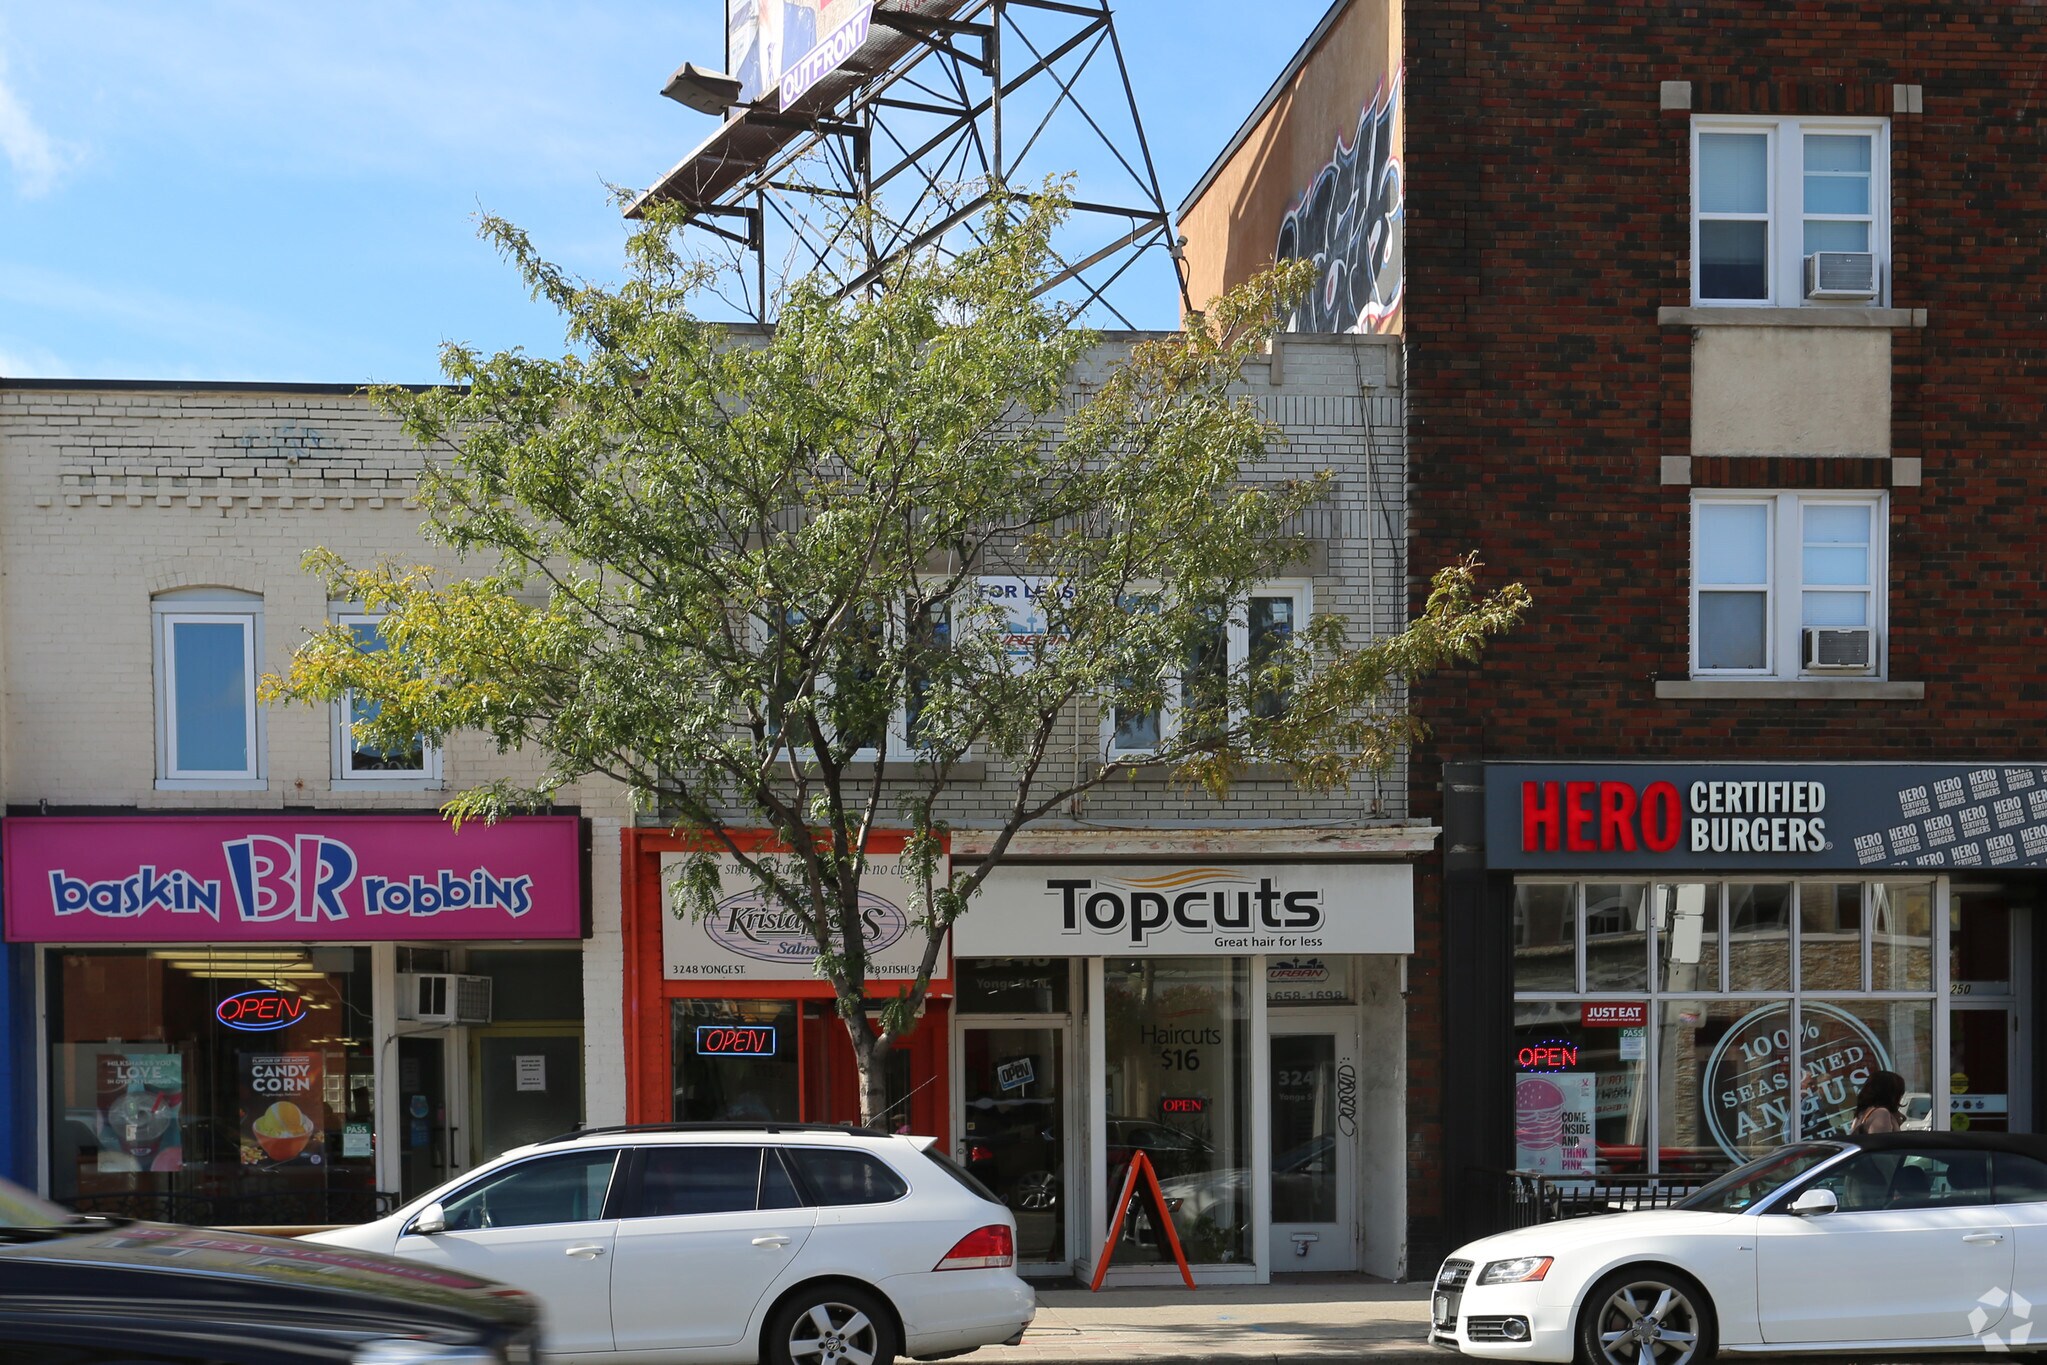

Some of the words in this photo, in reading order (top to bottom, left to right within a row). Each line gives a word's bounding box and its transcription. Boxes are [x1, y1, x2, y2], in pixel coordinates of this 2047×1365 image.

[782, 8, 867, 104] OUTFRONT
[979, 584, 1017, 598] FOR
[1968, 769, 1997, 785] HERO
[2007, 772, 2034, 783] CERTIFIED
[1933, 776, 1962, 794] HERO
[1972, 780, 1998, 793] CERTIFIED
[2008, 778, 2035, 791] BURGERS
[1690, 781, 1826, 813] CERTIFIED
[1899, 785, 1927, 804] HERO
[1937, 789, 1964, 801] CERTIFIED
[1974, 788, 2000, 800] BURGERS
[1902, 798, 1929, 811] CERTIFIED
[1939, 797, 1966, 810] BURGERS
[1993, 796, 2021, 814] HERO
[1521, 780, 1683, 852] HERO
[1904, 806, 1931, 819] BURGERS
[1959, 805, 1987, 823] HERO
[1997, 809, 2024, 821] CERTIFIED
[1924, 814, 1952, 832] HERO
[1962, 817, 1989, 830] CERTIFIED
[1998, 816, 2025, 829] BURGERS
[1691, 817, 1826, 852] BURGERS
[1889, 823, 1917, 841] HERO
[1927, 826, 1954, 839] CERTIFIED
[1964, 825, 1991, 838] BURGERS
[1854, 833, 1882, 850] HERO
[1892, 835, 1919, 848] CERTIFIED
[1929, 834, 1956, 847] BURGERS
[1986, 833, 2014, 851] HERO
[1857, 844, 1884, 858] CERTIFIED
[1894, 843, 1921, 856] BURGERS
[1951, 842, 1980, 860] HERO
[1989, 846, 2016, 858] CERTIFIED
[1859, 852, 1886, 865] BURGERS
[872, 865, 888, 875] no
[222, 833, 358, 922] BR
[1046, 878, 1322, 943] Topcuts
[1214, 936, 1249, 948] Great
[1252, 936, 1275, 948] hair
[1278, 936, 1298, 948] for
[1301, 936, 1323, 948] less
[673, 964, 699, 974] 3248
[701, 964, 733, 974] YONGE
[734, 964, 746, 974] ST.
[1270, 969, 1324, 979] URBAN
[1951, 984, 1971, 995] 250
[219, 998, 301, 1020] OPEN
[1587, 1007, 1617, 1018] JUST
[1618, 1007, 1642, 1018] EAT
[1140, 1024, 1222, 1045] Haircuts
[1623, 1029, 1643, 1037] PASS
[706, 1028, 767, 1053] OPEN
[1739, 1019, 1820, 1063] 100%
[1161, 1048, 1200, 1071] $16
[1518, 1047, 1576, 1067] OPEN
[117, 1066, 162, 1079] LOVE
[252, 1065, 311, 1078] CANDY
[1001, 1062, 1030, 1082] OPEN
[252, 1078, 310, 1092] CORN
[1163, 1099, 1202, 1112] OPEN
[1735, 1066, 1871, 1140] ANGUS
[1562, 1112, 1587, 1123] COME
[346, 1126, 367, 1134] PASS
[1562, 1124, 1591, 1134] INSIDE
[1562, 1136, 1580, 1147] AND
[1562, 1148, 1588, 1158] THINK
[1562, 1160, 1585, 1170] PINK.
